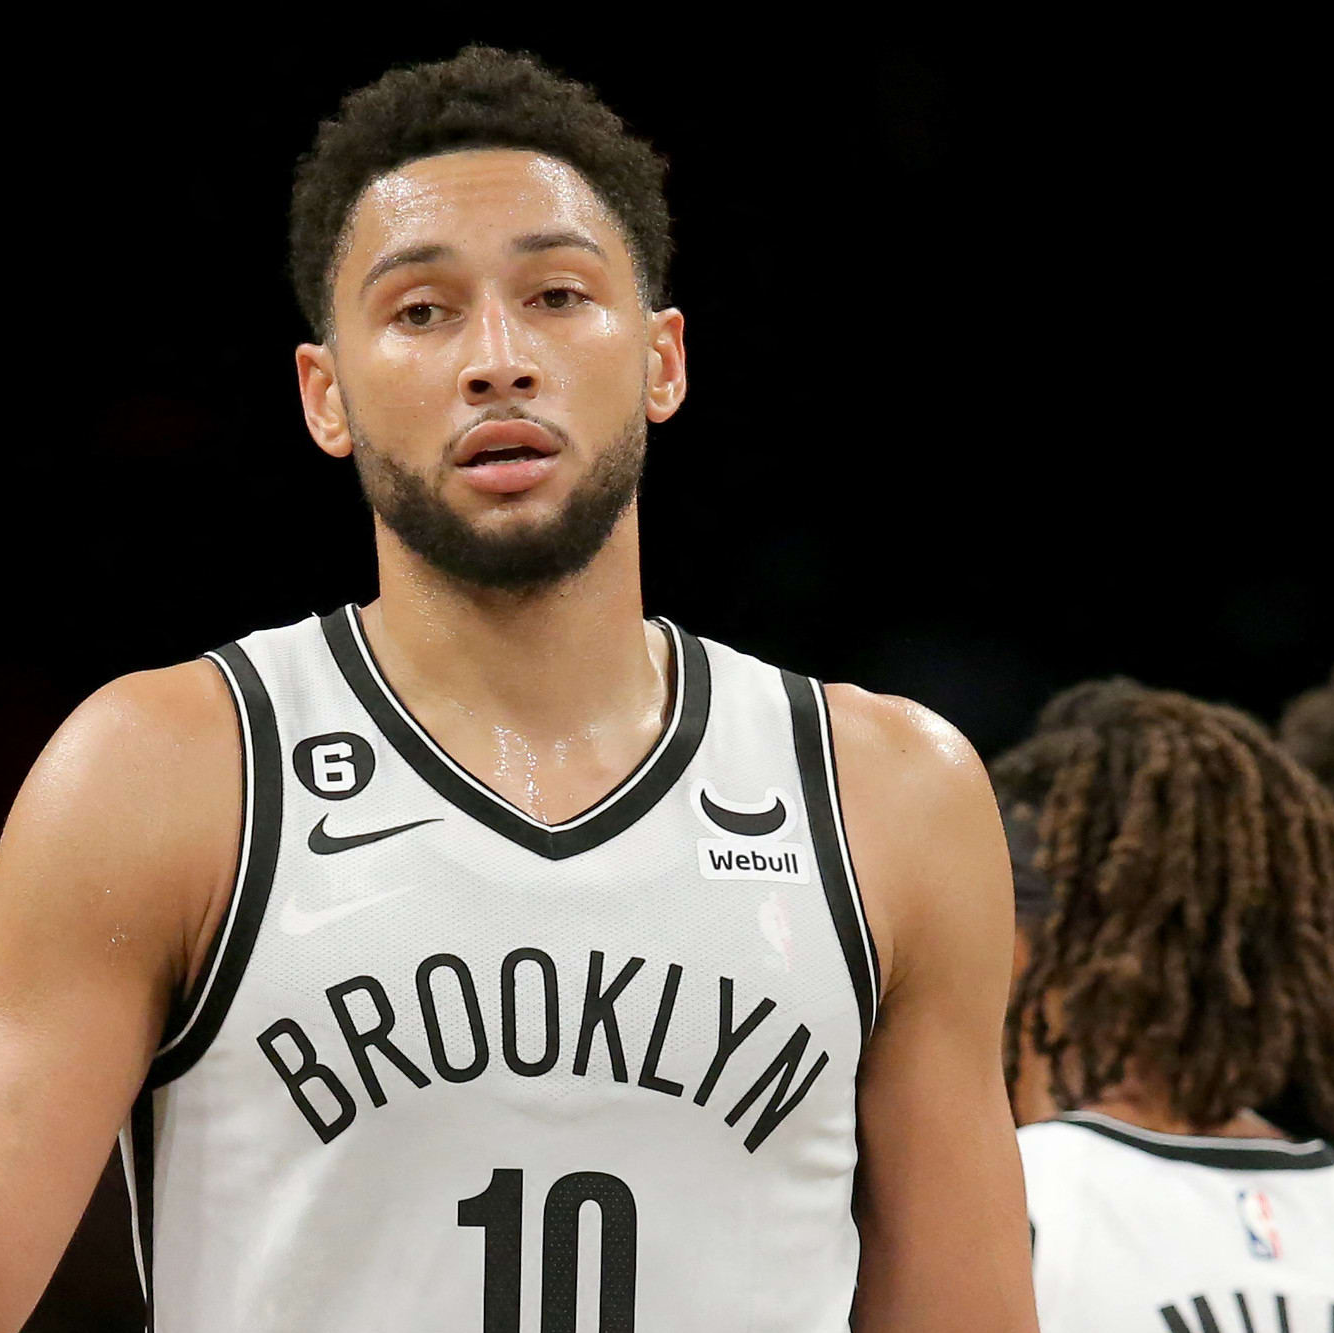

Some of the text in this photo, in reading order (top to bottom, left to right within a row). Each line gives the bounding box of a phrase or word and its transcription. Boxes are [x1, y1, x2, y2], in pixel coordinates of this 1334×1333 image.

[310, 742, 357, 792] 6
[708, 849, 799, 874] Webull
[257, 947, 830, 1154] BROOKLYN
